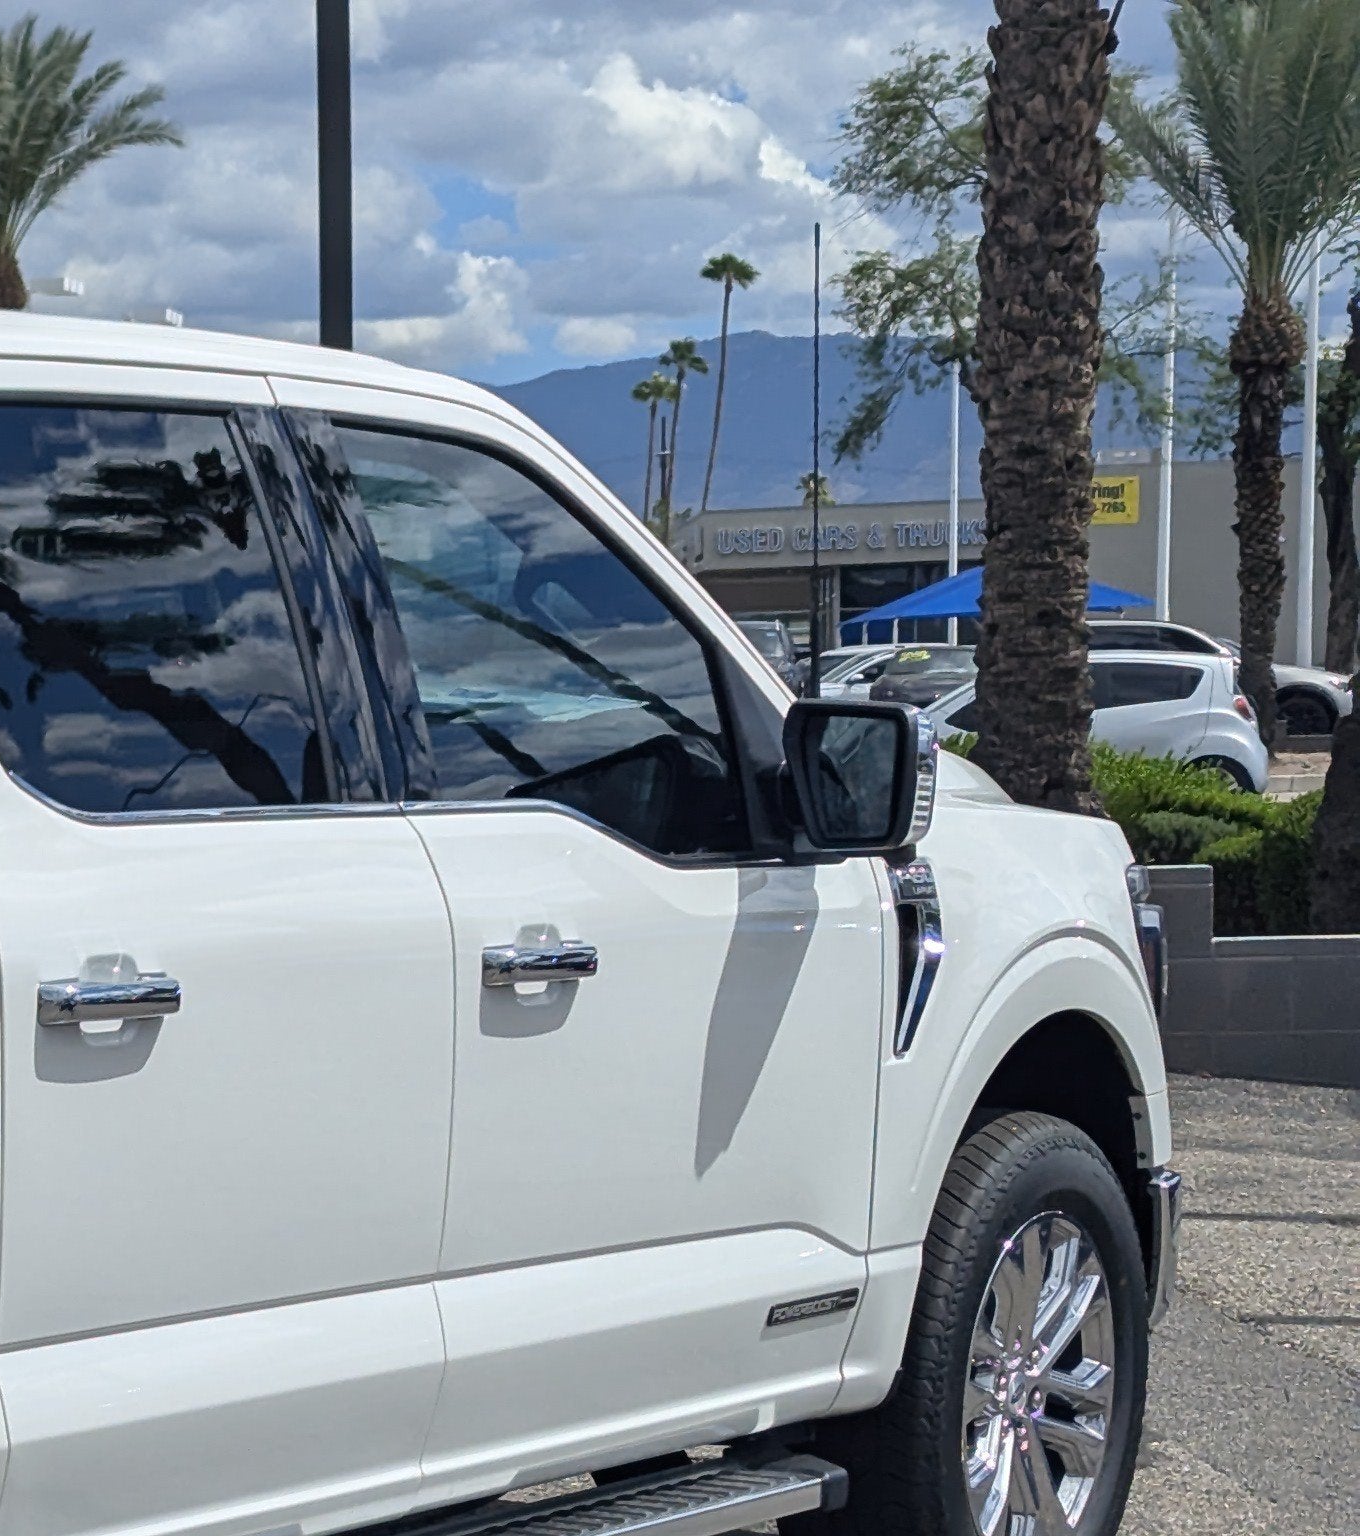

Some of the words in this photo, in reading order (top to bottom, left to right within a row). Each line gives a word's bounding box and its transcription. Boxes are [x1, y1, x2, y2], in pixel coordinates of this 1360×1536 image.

[717, 526, 785, 555] USED
[792, 523, 859, 550] CARS
[865, 519, 887, 550] &
